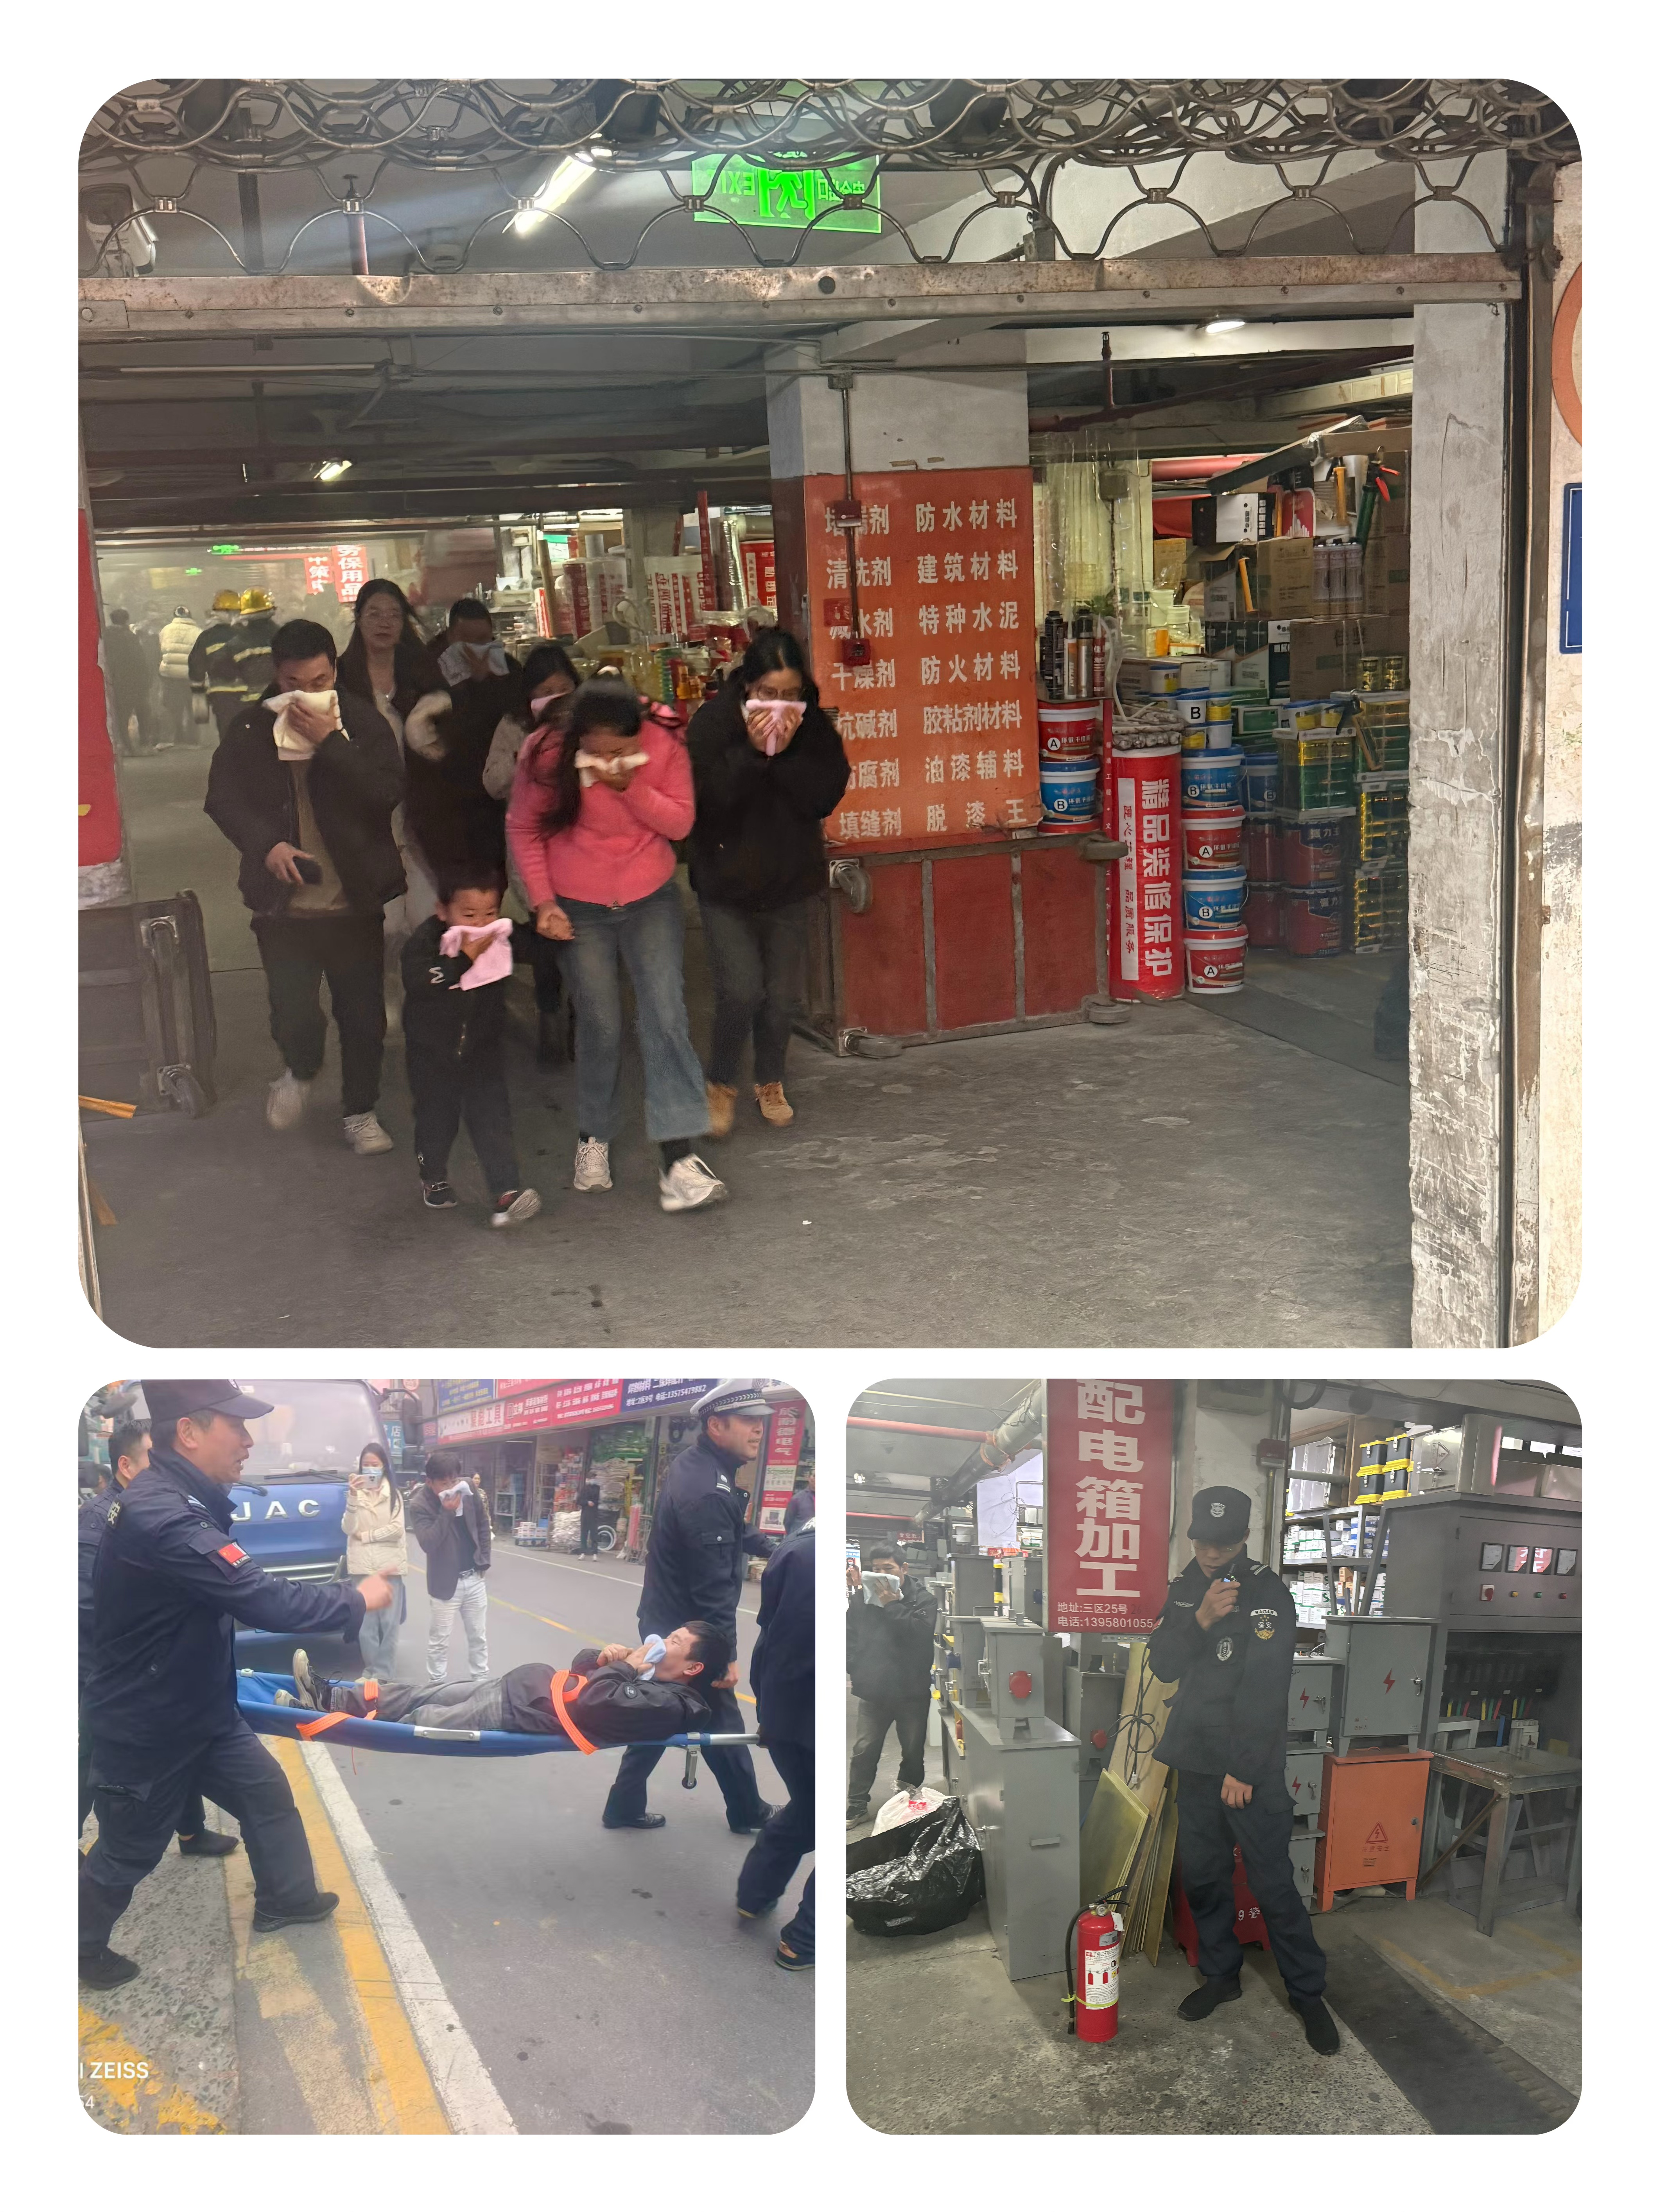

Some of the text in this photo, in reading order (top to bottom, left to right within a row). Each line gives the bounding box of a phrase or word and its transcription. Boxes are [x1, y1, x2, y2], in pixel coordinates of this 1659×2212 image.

[916, 498, 1017, 532] 防水材料
[337, 545, 364, 596] 劳保用品
[827, 550, 1018, 589] 清洗剂 建筑材料
[919, 602, 1019, 635] 特种水泥
[831, 651, 1021, 691] 干燥剂 防火材料
[924, 700, 1022, 734] 胶粘剂材料
[1191, 706, 1200, 719] B
[1050, 739, 1058, 748] A
[925, 749, 1024, 783] 油漆辅料
[1190, 786, 1196, 795] B
[1057, 801, 1065, 809] B
[839, 799, 1027, 839] 填缝剂 脱漆王
[1202, 847, 1210, 856] A
[1141, 778, 1172, 976] 精品装修保护
[1125, 889, 1135, 954] 品质服务
[1202, 908, 1210, 917] B
[1207, 966, 1215, 975] A
[1074, 1379, 1145, 1597] 配电箱加工
[230, 1499, 320, 1522] JAC
[1057, 1602, 1128, 1614] 地址:三区25号
[1058, 1616, 1153, 1628] 电话:1395801055
[1238, 1909, 1245, 1921] 9
[1248, 1907, 1261, 1919] 警
